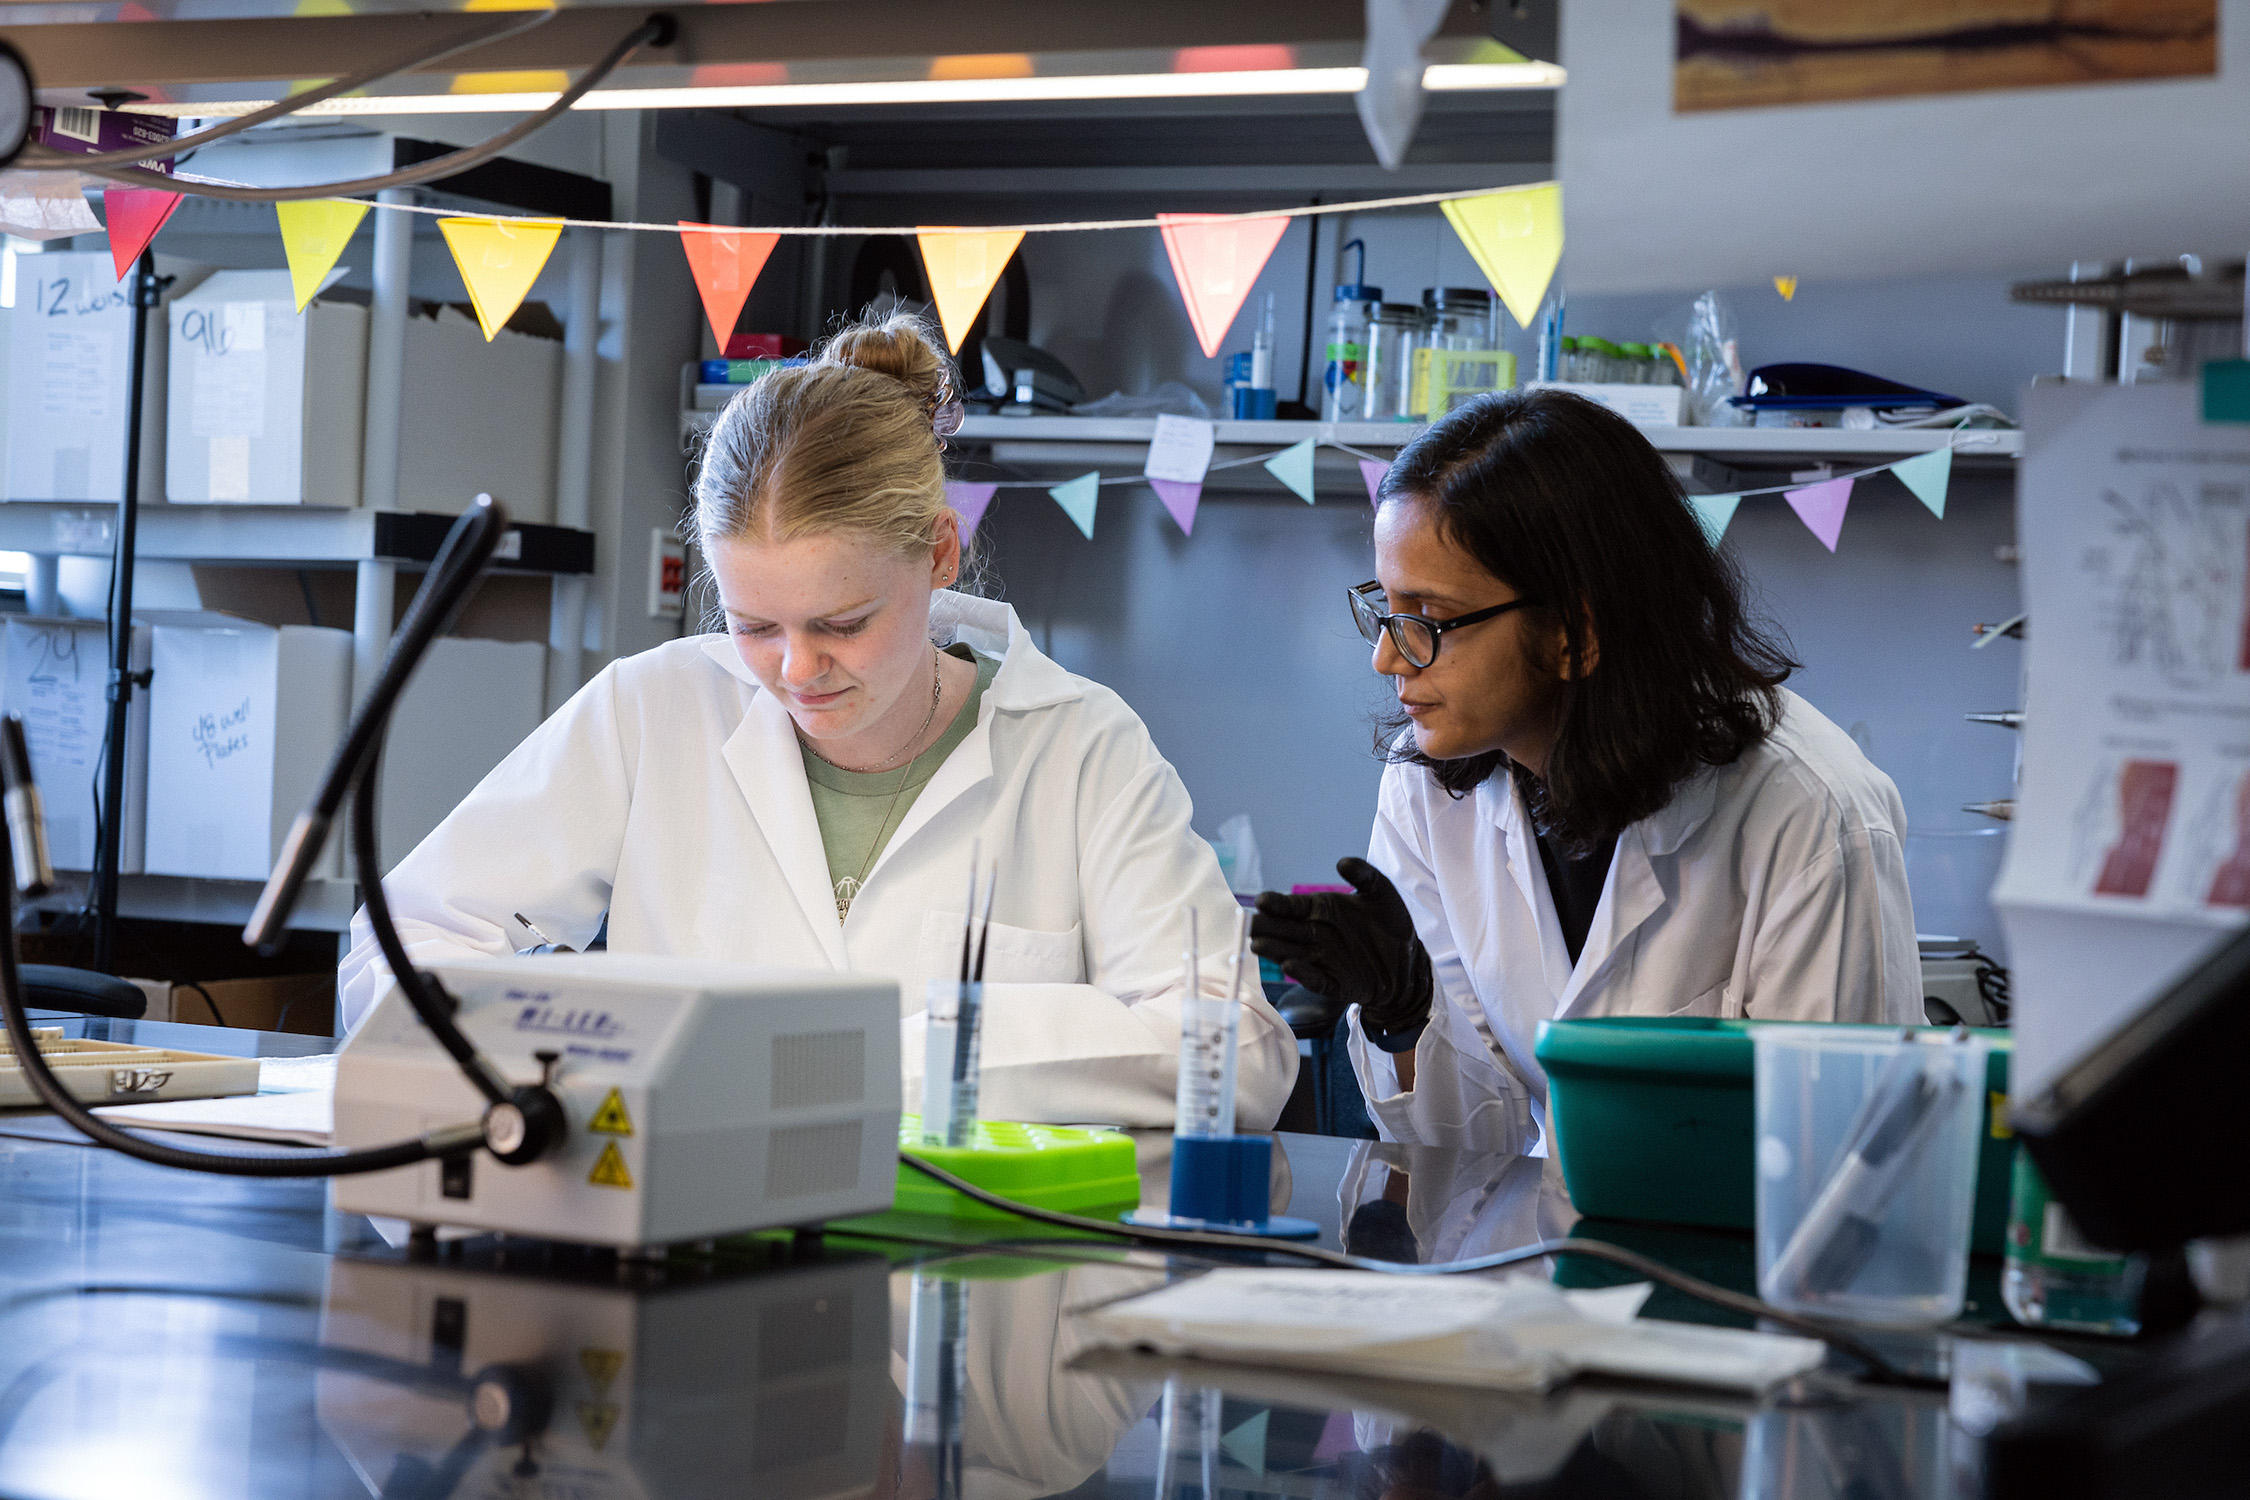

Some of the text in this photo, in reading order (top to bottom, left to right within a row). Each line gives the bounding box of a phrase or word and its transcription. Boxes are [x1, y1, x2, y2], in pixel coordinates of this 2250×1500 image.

[36, 276, 70, 316] 12
[182, 309, 234, 356] 96
[27, 628, 80, 683] 24
[192, 711, 216, 742] 48
